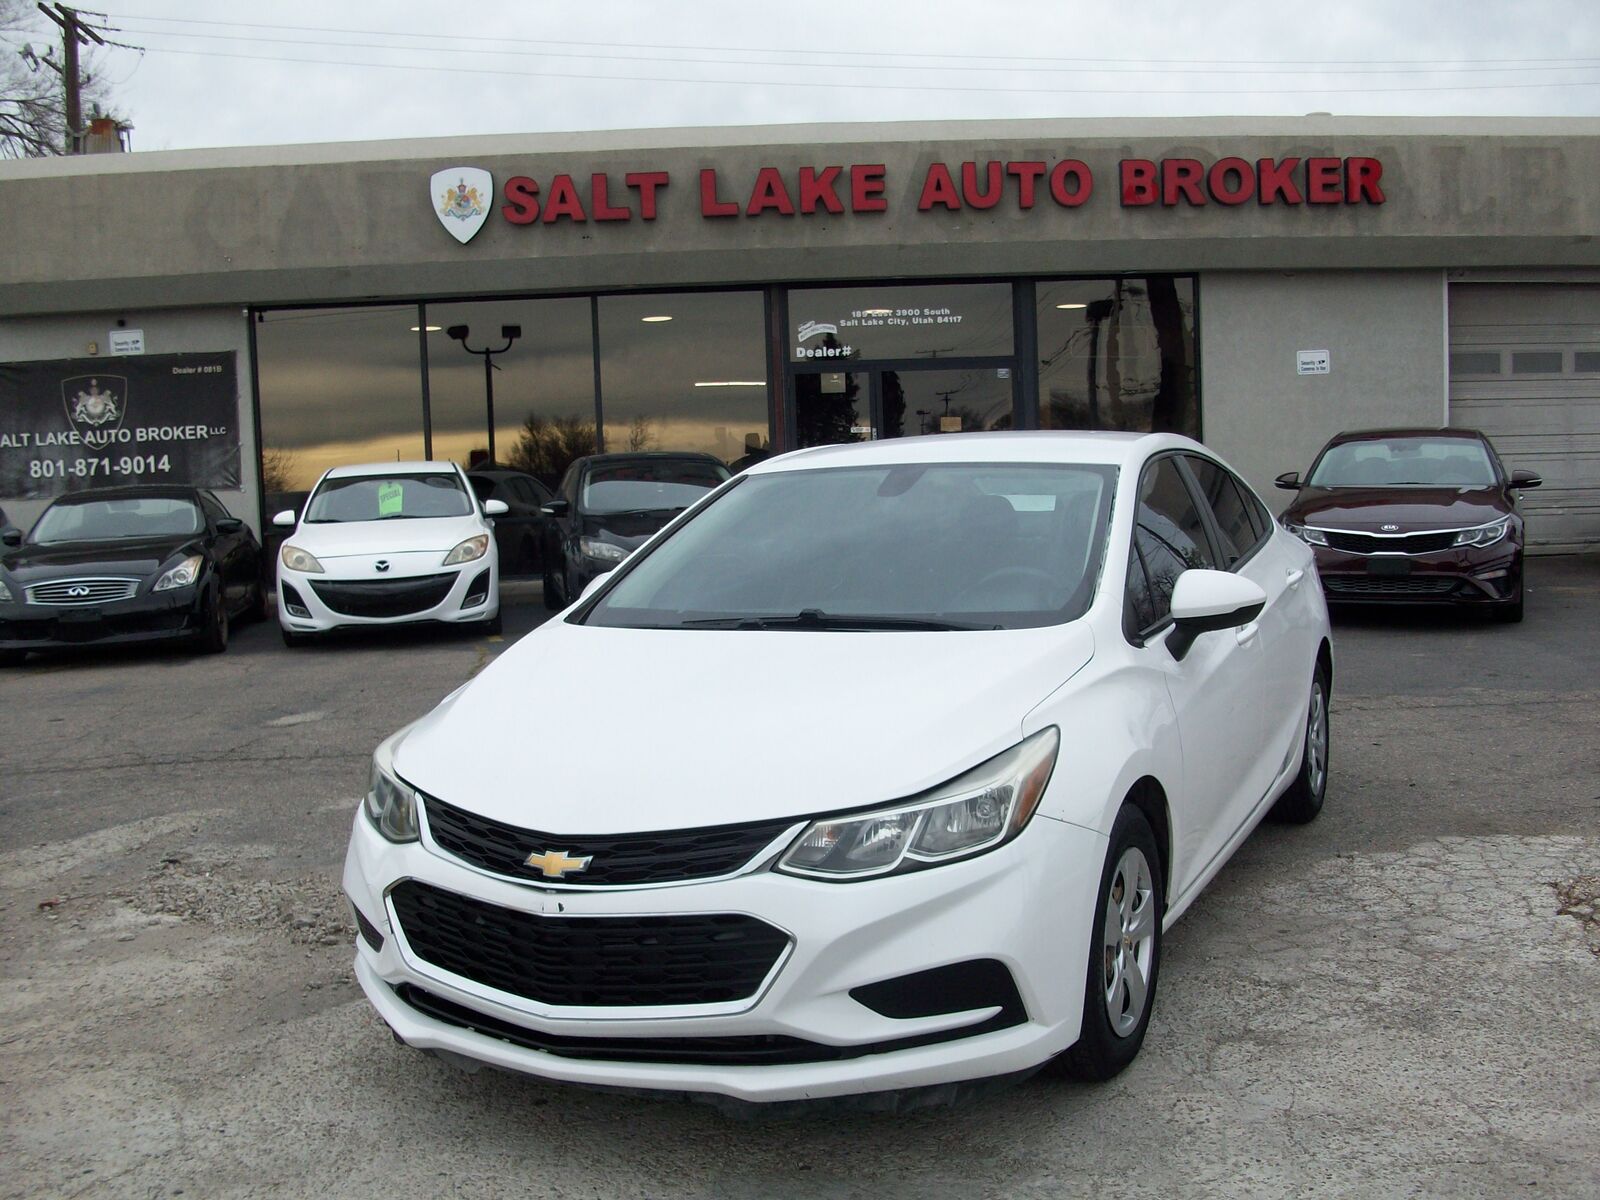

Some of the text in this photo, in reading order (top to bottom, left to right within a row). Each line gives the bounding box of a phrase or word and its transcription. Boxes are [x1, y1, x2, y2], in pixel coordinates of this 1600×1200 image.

[502, 171, 670, 224] SALT
[700, 164, 888, 217] LAKE
[917, 158, 1094, 211] AUTO
[1119, 157, 1387, 208] BROKER
[923, 308, 951, 316] South
[840, 319, 858, 327] Salt
[862, 318, 884, 326] Lake
[172, 366, 196, 375] Dealer
[35, 431, 81, 446] LAKE
[84, 428, 131, 444] AUTO
[136, 425, 208, 442] BROKER
[210, 426, 227, 435] LLC
[30, 454, 171, 478] 801-871-9014
